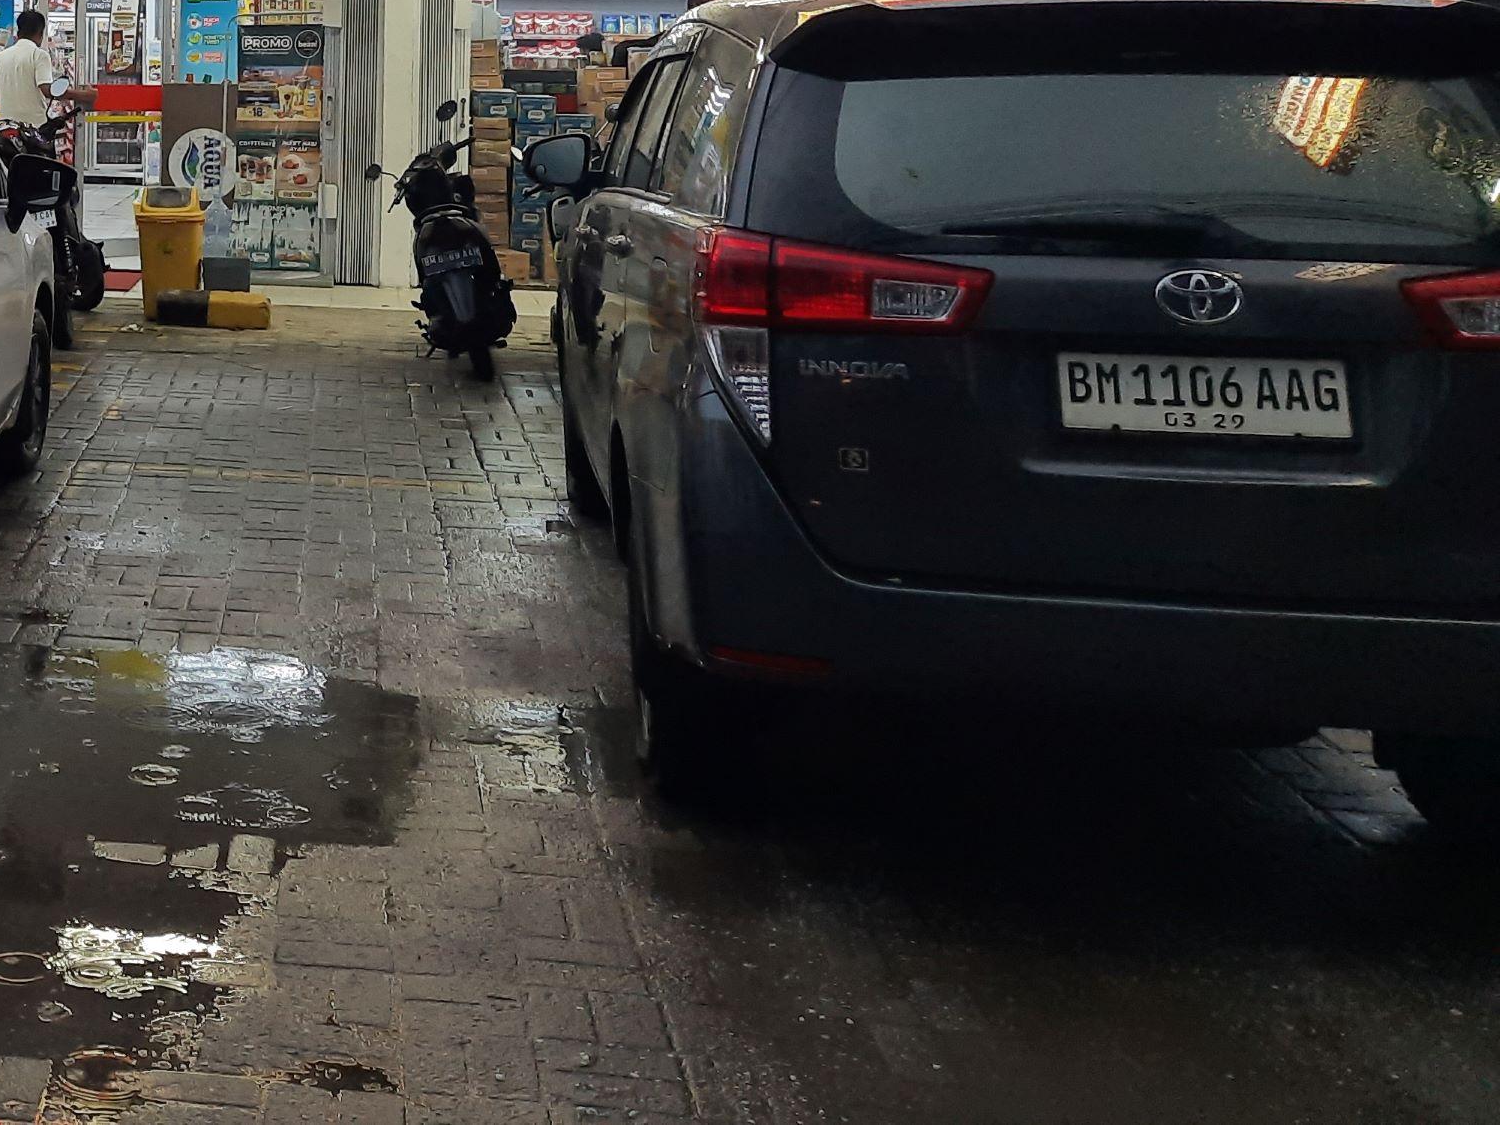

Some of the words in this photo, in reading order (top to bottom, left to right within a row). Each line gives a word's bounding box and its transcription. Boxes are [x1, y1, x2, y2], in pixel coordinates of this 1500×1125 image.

[244, 38, 290, 48] PROMO
[200, 135, 221, 189] AQUA
[1067, 361, 1122, 405] BM
[1132, 363, 1244, 408] 1106
[1256, 367, 1340, 412] AAG
[1213, 413, 1245, 428] 29
